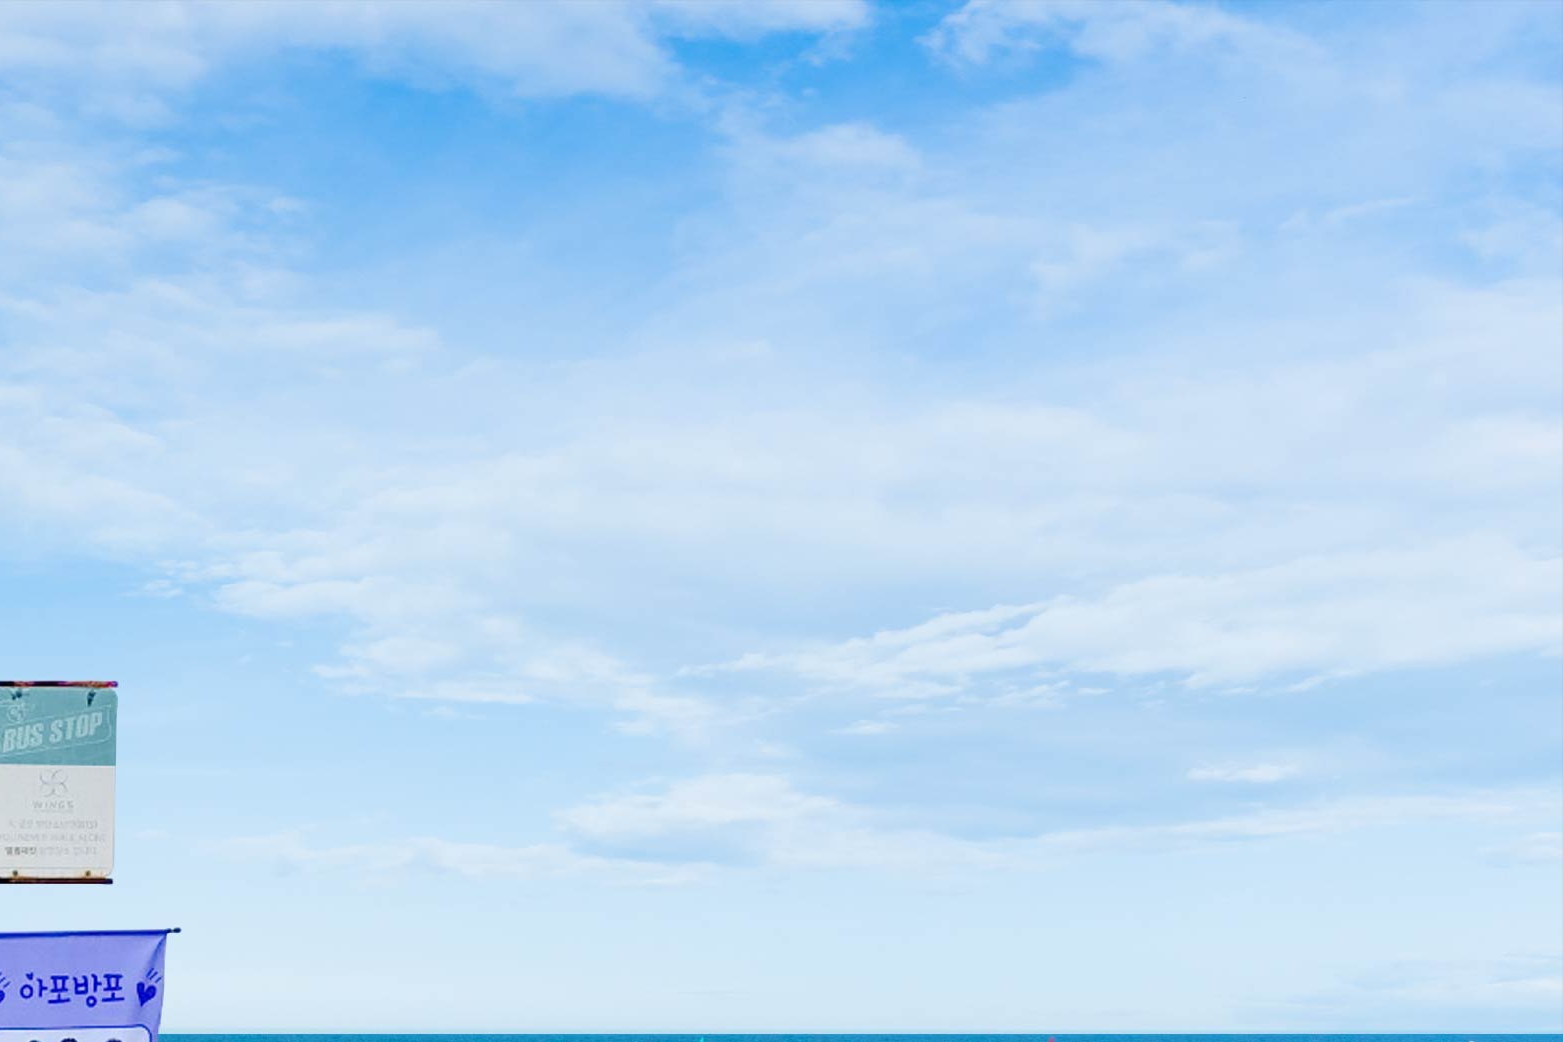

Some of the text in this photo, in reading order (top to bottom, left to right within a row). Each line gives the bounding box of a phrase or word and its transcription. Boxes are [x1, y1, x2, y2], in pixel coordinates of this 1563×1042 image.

[2, 712, 103, 753] BUS STOP
[19, 972, 125, 1008] 아포방포
